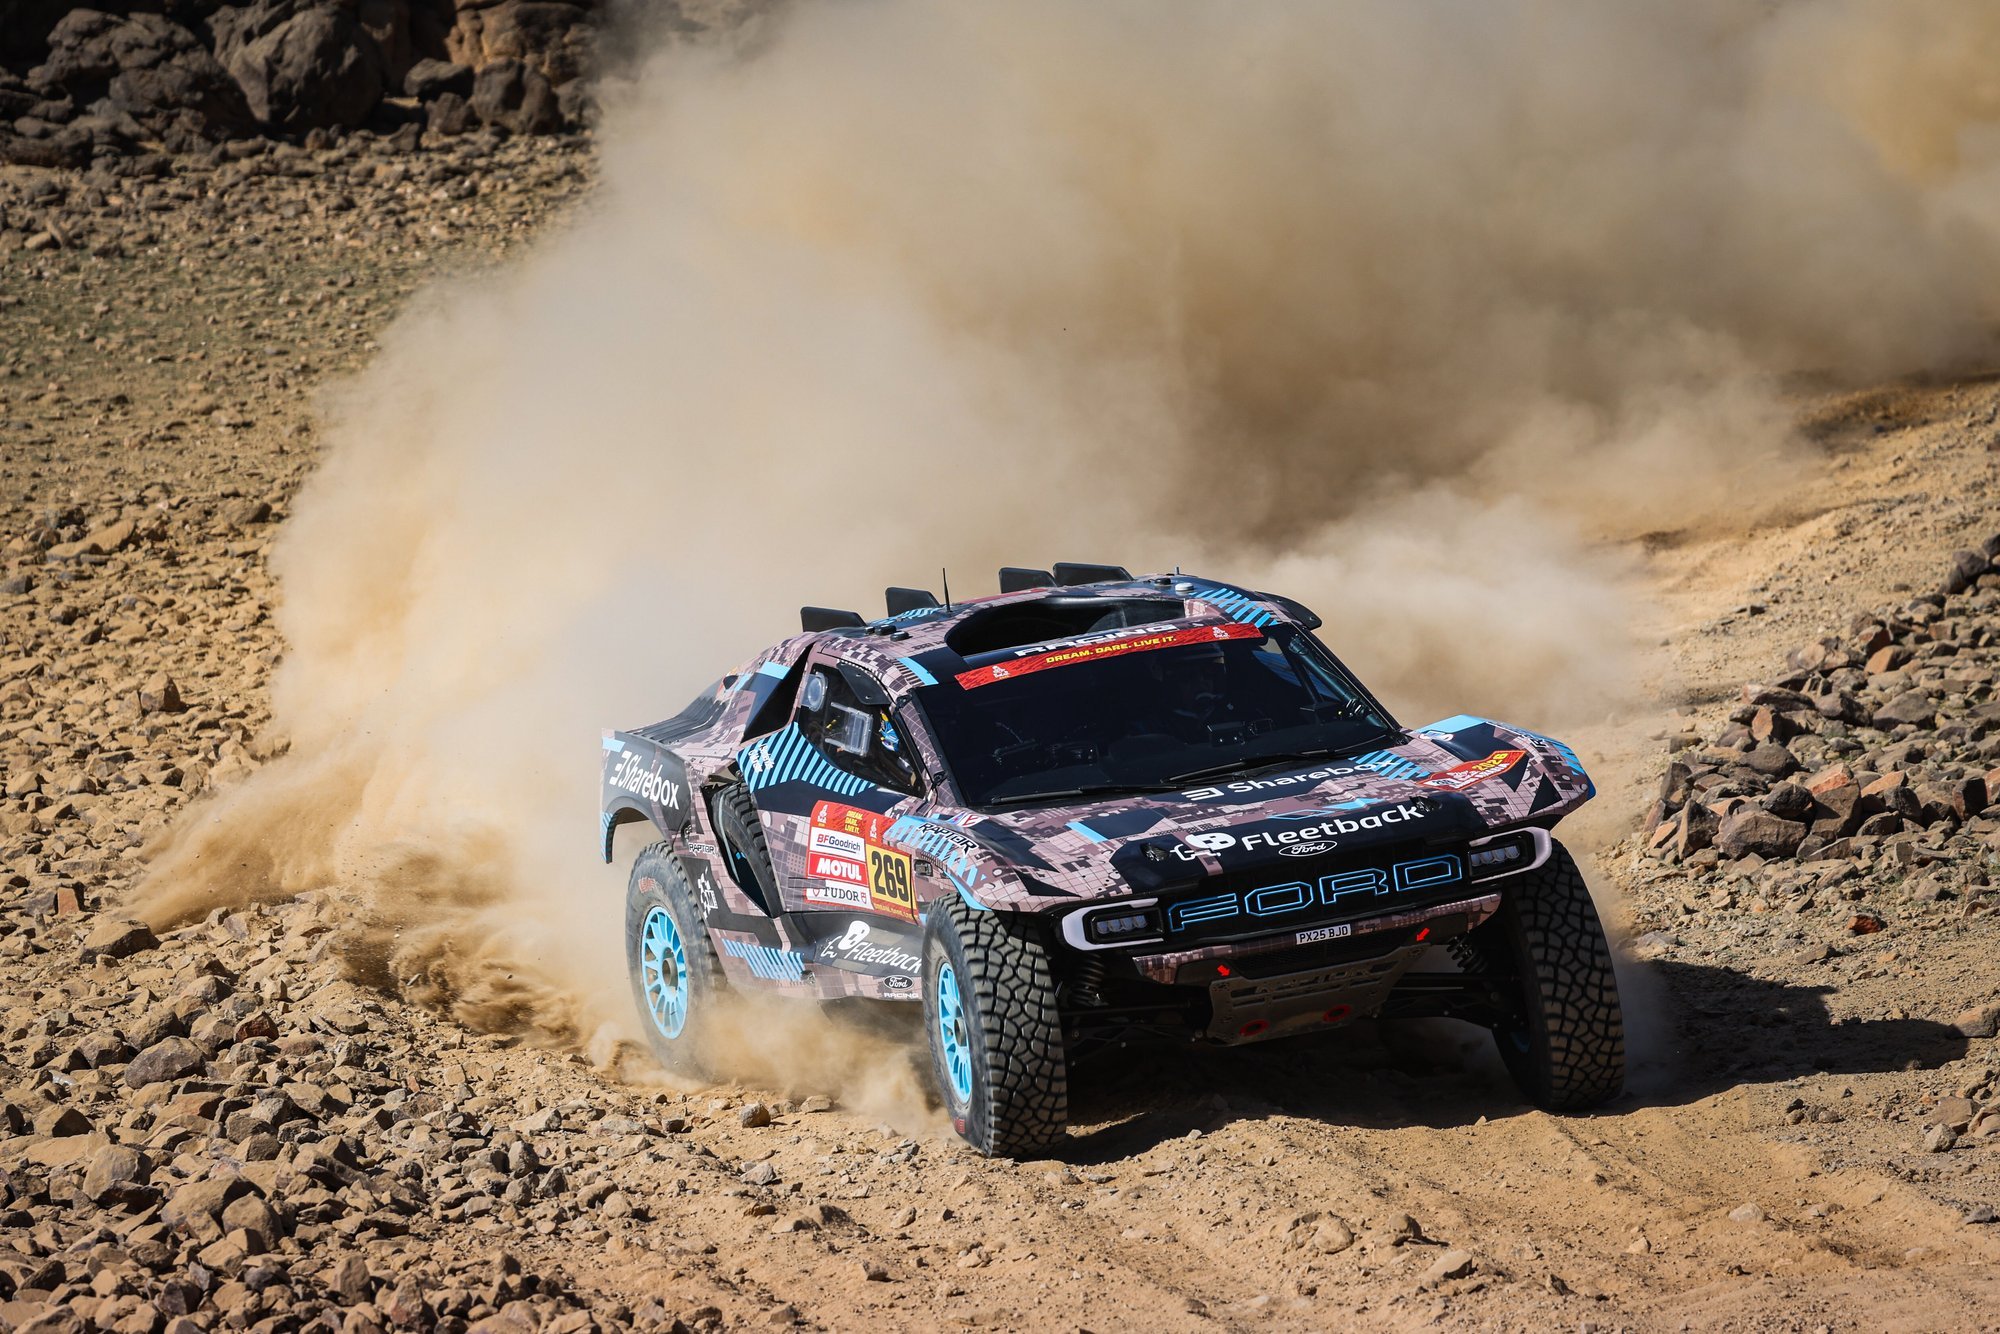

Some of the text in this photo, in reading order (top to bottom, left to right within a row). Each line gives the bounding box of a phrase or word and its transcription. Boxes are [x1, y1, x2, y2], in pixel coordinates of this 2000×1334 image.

[1046, 636, 1176, 663] DREAM. DARE. LIVE IT.
[619, 754, 679, 810] Sharebox
[1228, 760, 1397, 792] Sharebox
[816, 833, 861, 851] BFGoodrich
[918, 822, 979, 857] RAPTOR
[1241, 804, 1424, 850] Fleetback
[816, 857, 861, 881] MOTUL
[871, 850, 909, 902] 269
[824, 887, 860, 902] TUDOR
[1168, 854, 1463, 932] FORD
[1299, 925, 1349, 943] PX25 BJO
